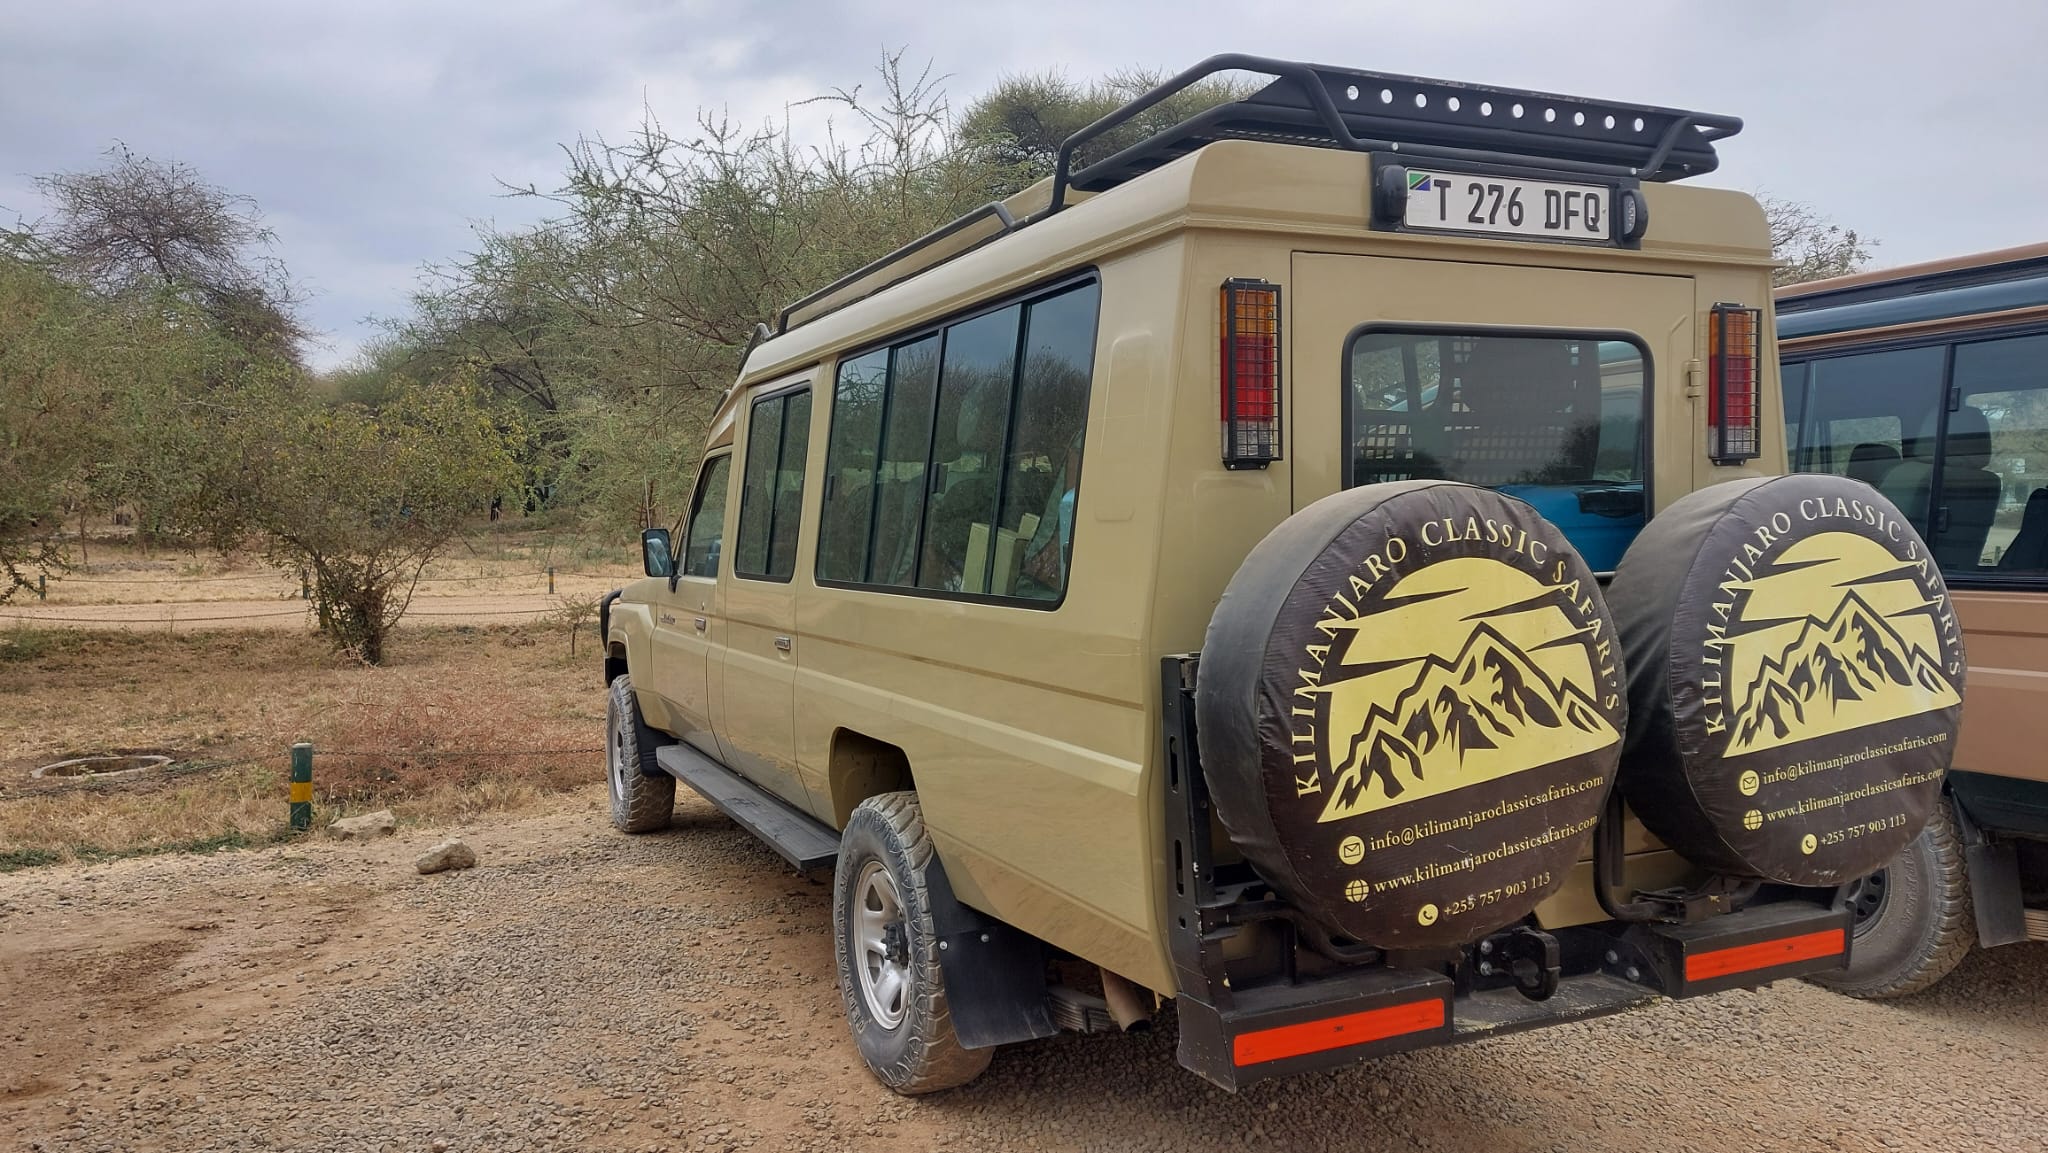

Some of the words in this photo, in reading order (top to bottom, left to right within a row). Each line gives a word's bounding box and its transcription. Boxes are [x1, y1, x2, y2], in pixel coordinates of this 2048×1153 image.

[1433, 178, 1452, 222] T
[1467, 182, 1525, 227] 276
[1544, 188, 1601, 233] DFQ
[1702, 511, 1792, 737] KILIMANJARO
[1800, 496, 1901, 543] CLASSIC
[1907, 540, 1961, 677] SAFARI'S
[1291, 536, 1407, 799] KILIMANJARO
[1421, 516, 1548, 565] CLASSIC
[1552, 560, 1620, 711] SAFARI'S
[1762, 731, 1948, 786] info@kilimanjaroclassicsafaris.com
[1369, 775, 1604, 852] info@kilimanjaroclassicsafaris.com
[1766, 766, 1946, 823] www.kilimanjaroclassicsafaris.com
[1374, 813, 1598, 894] www.kilimanjaroclassicsafaris.com
[1820, 830, 1845, 846] +255
[1848, 824, 1866, 839] 757
[1868, 819, 1887, 834] 903
[1890, 813, 1906, 828] 113
[1443, 896, 1476, 917] +255
[1479, 888, 1502, 908] 757
[1505, 882, 1528, 899] 903
[1531, 871, 1551, 890] 113
